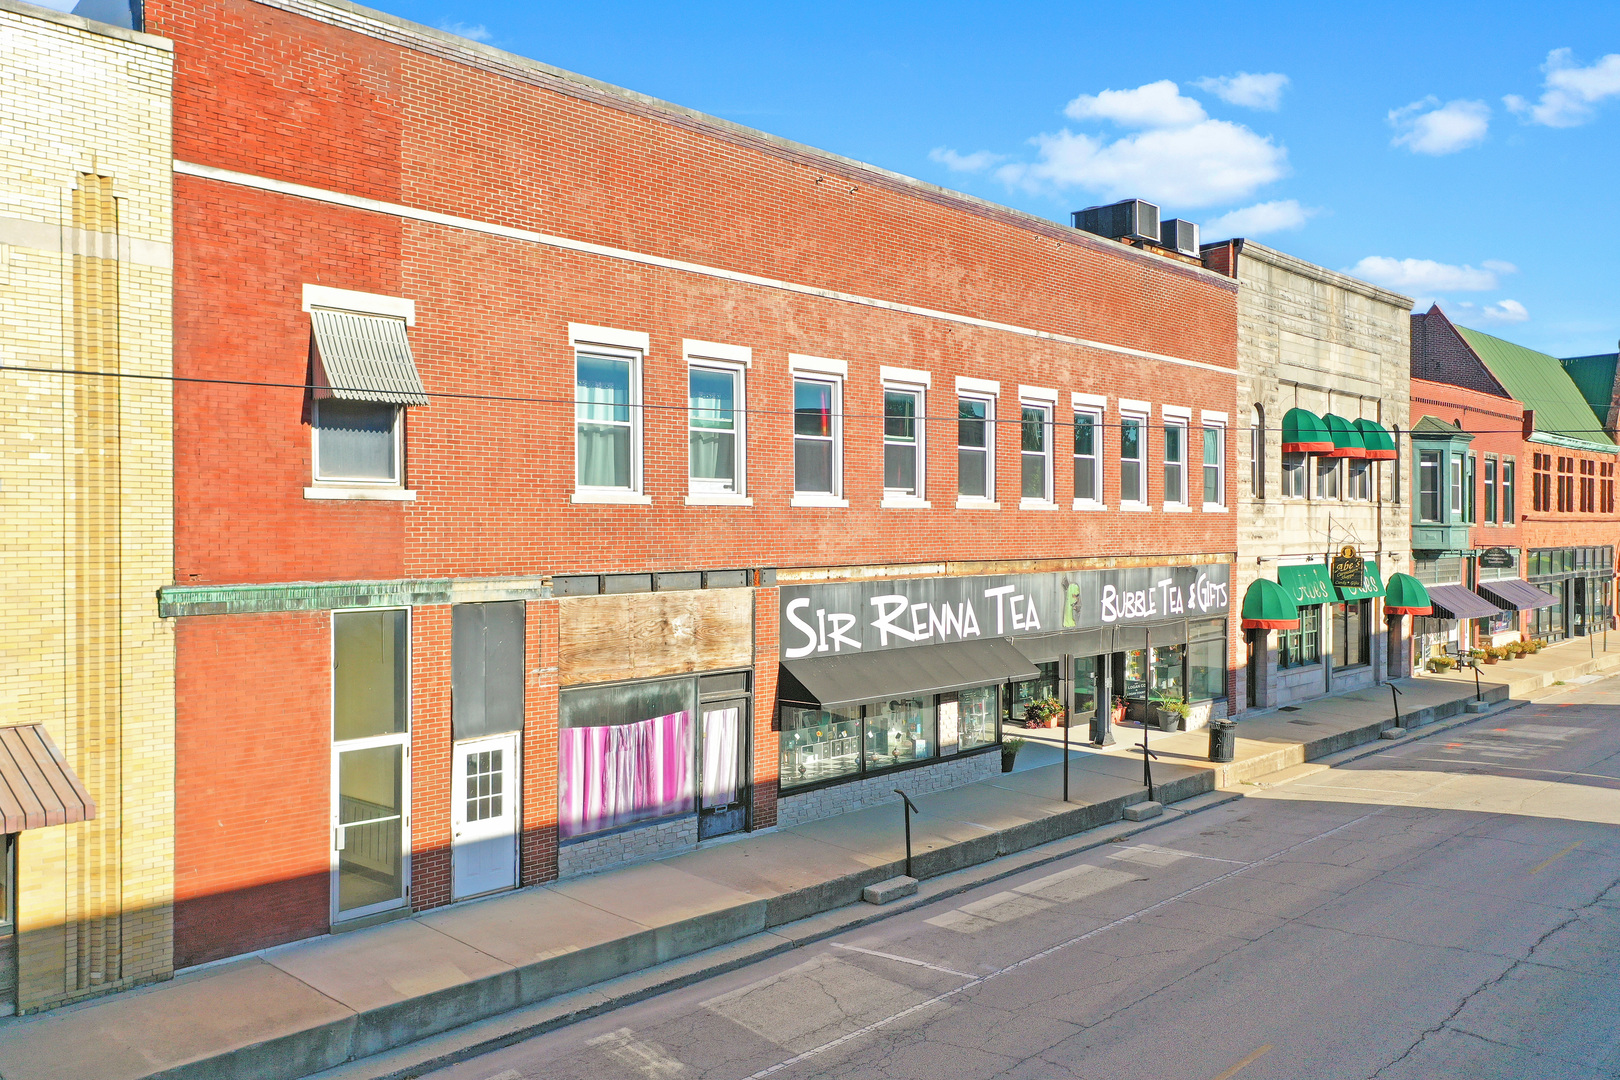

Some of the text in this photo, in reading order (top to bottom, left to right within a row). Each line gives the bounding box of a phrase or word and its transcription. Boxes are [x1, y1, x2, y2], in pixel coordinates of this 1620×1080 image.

[785, 597, 862, 658] SIR
[870, 594, 981, 647] RENNA
[984, 584, 1041, 634] TEA
[1101, 584, 1157, 622] BUBBLE
[1158, 577, 1184, 615] TEA
